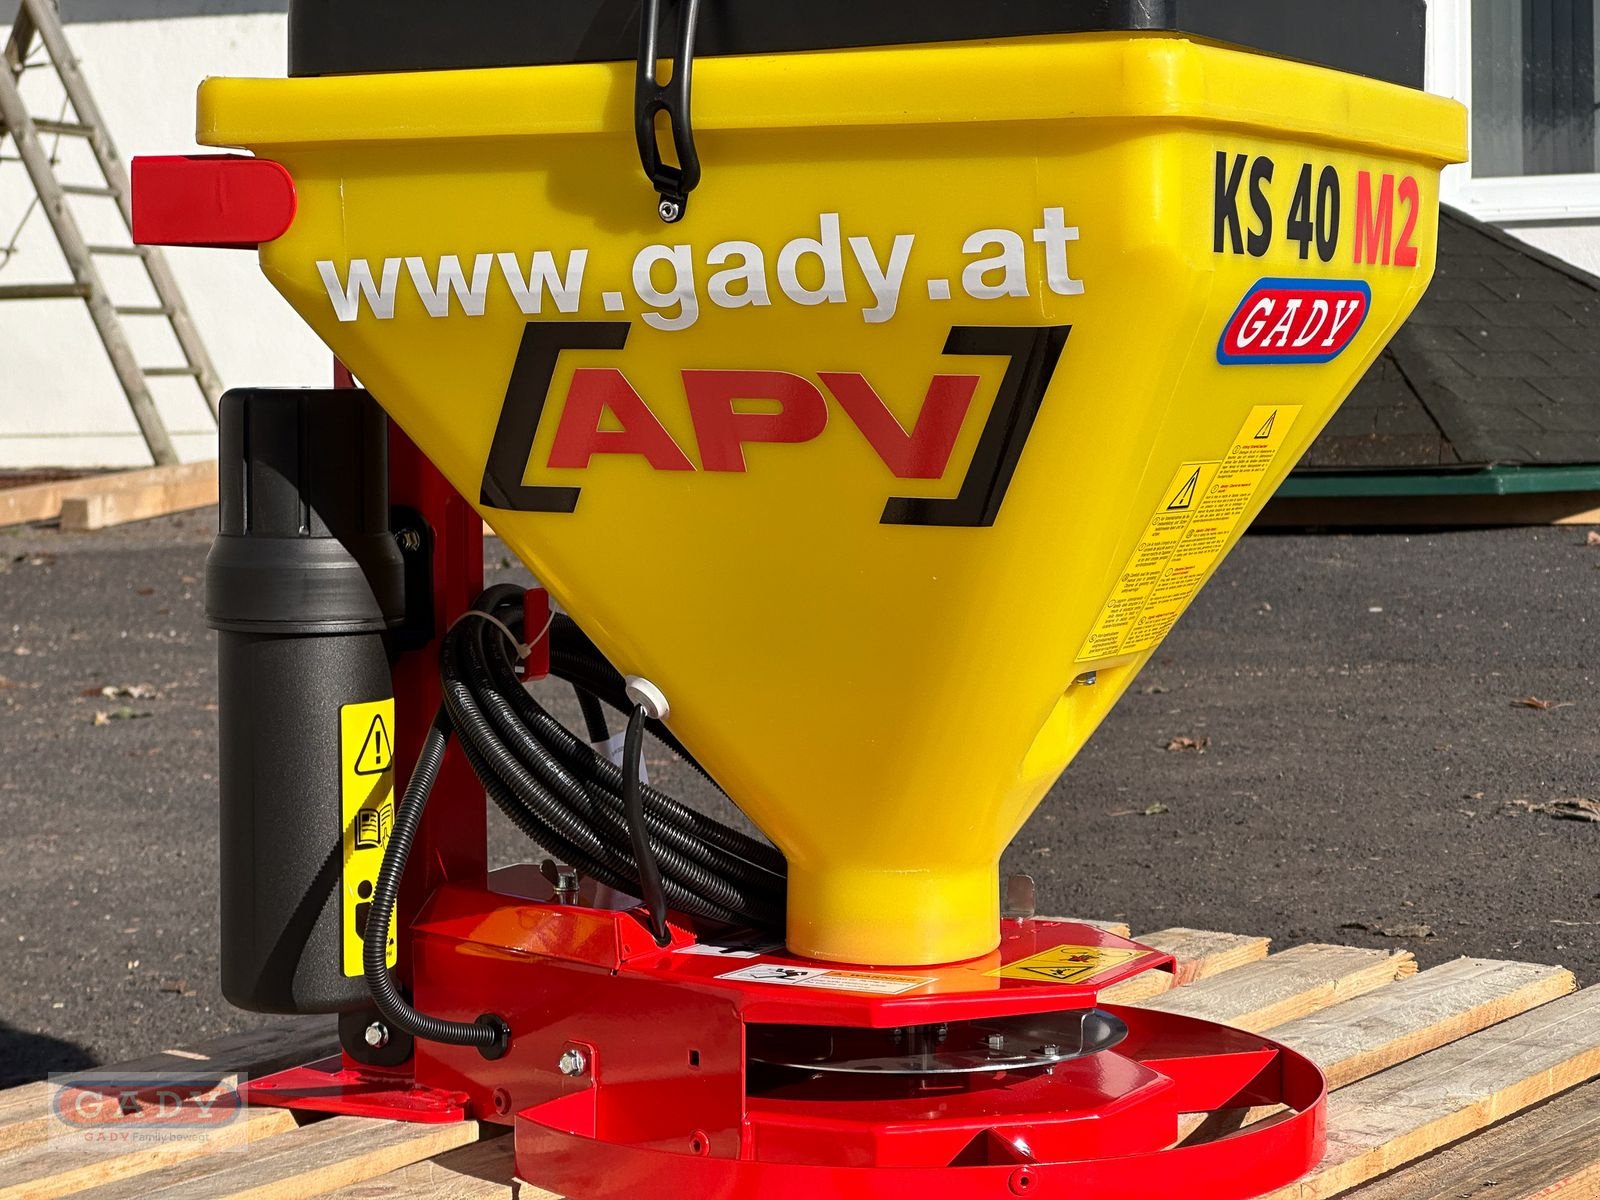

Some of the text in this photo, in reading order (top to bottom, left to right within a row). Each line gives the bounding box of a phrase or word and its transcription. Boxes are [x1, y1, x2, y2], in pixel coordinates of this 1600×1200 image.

[1213, 151, 1419, 267] KS 40 M2
[316, 207, 1084, 332] www.gady.at
[1237, 297, 1358, 348] GADY
